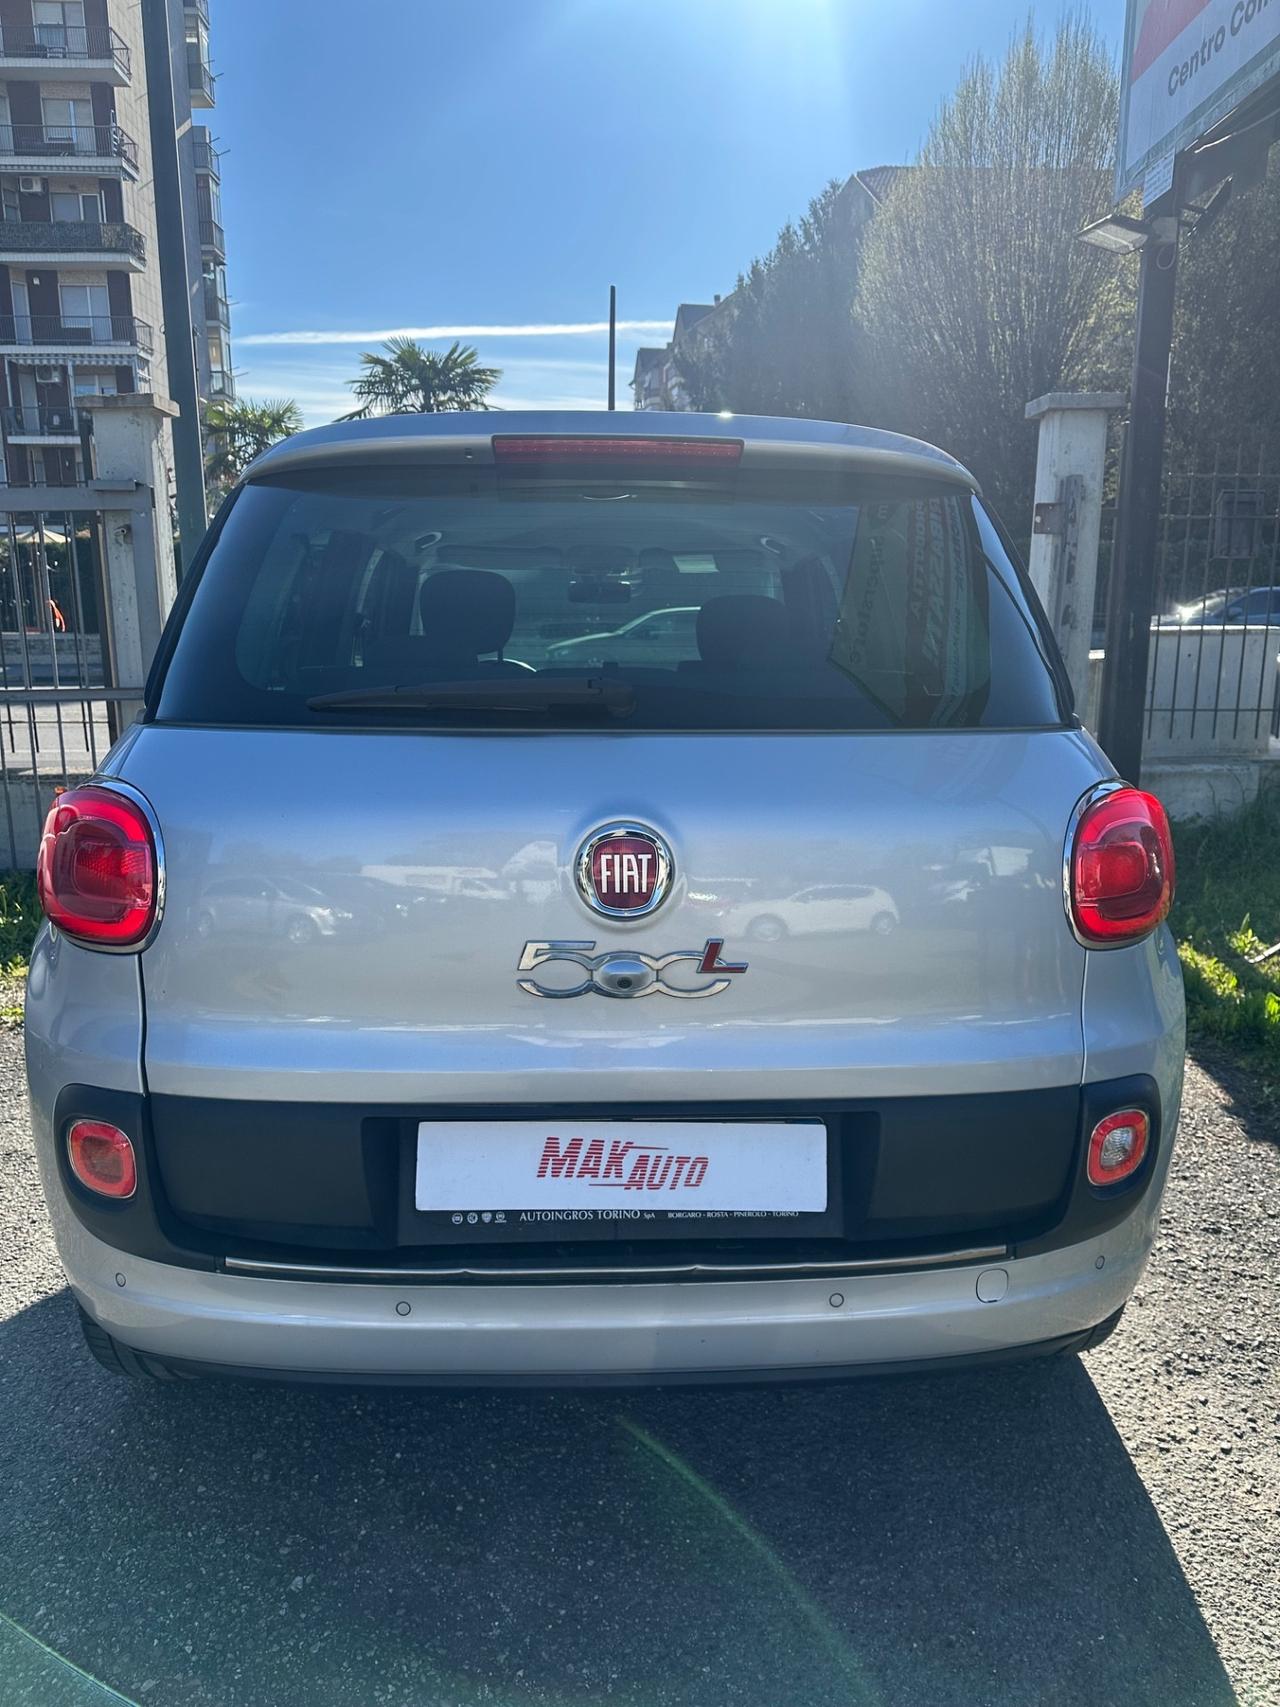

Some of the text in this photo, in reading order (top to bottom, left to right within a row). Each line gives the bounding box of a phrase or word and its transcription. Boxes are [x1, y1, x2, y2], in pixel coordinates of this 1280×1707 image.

[1168, 25, 1226, 97] Centro
[600, 853, 652, 894] FIAT
[536, 1136, 709, 1191] MAK AUTO
[519, 1210, 594, 1222] AUTOINGROS
[598, 1209, 641, 1220] TORINO
[772, 1210, 799, 1218] TORINO
